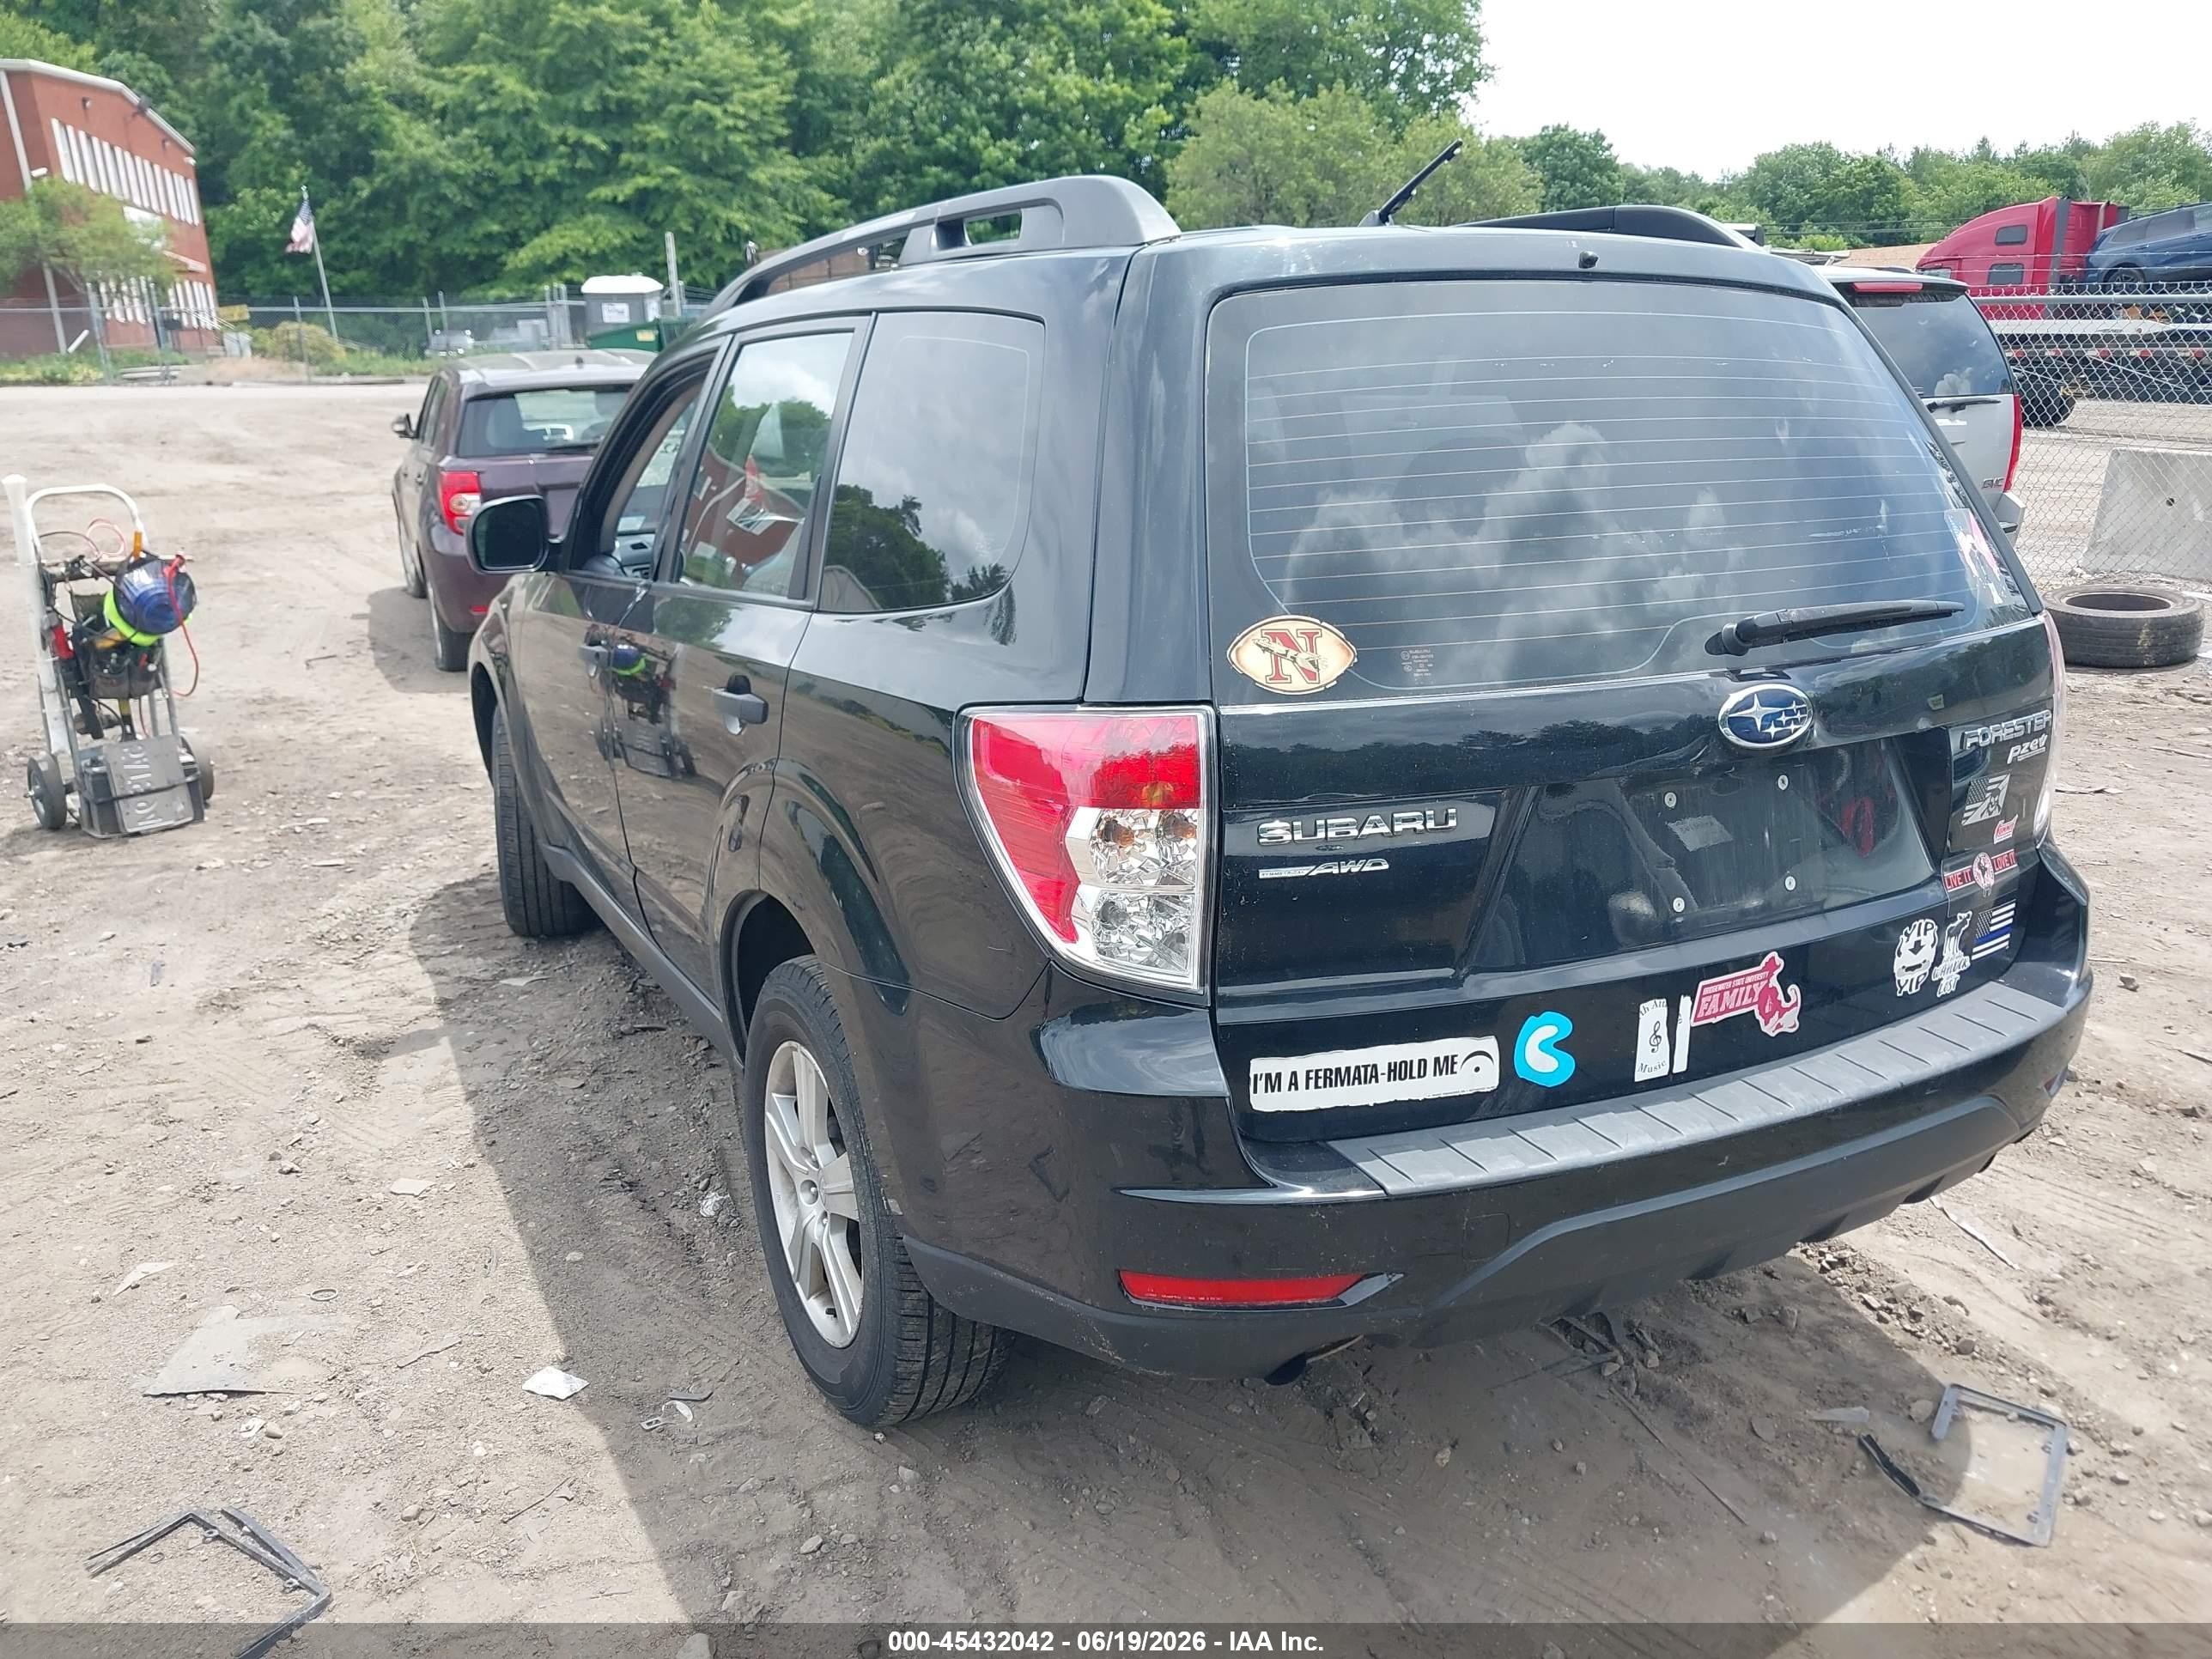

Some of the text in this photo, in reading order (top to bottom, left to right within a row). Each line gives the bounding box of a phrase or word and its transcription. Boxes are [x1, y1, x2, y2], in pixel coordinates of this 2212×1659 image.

[1960, 709, 2053, 750] FORESTER
[1258, 808, 1457, 846] SUBARU
[1307, 859, 1389, 877] AWD
[1945, 871, 1964, 890] LIVE
[1963, 868, 1972, 884] IT
[1993, 854, 2011, 872] LOVE
[2010, 850, 2017, 865] IT
[1904, 921, 1935, 944] YIP
[1696, 979, 1769, 1018] FAMILY
[1896, 971, 1929, 995] YIP
[1252, 1072, 1282, 1095] I'M
[1287, 1070, 1299, 1092] A
[1432, 1054, 1459, 1077] ME
[1637, 1060, 1668, 1073] Music
